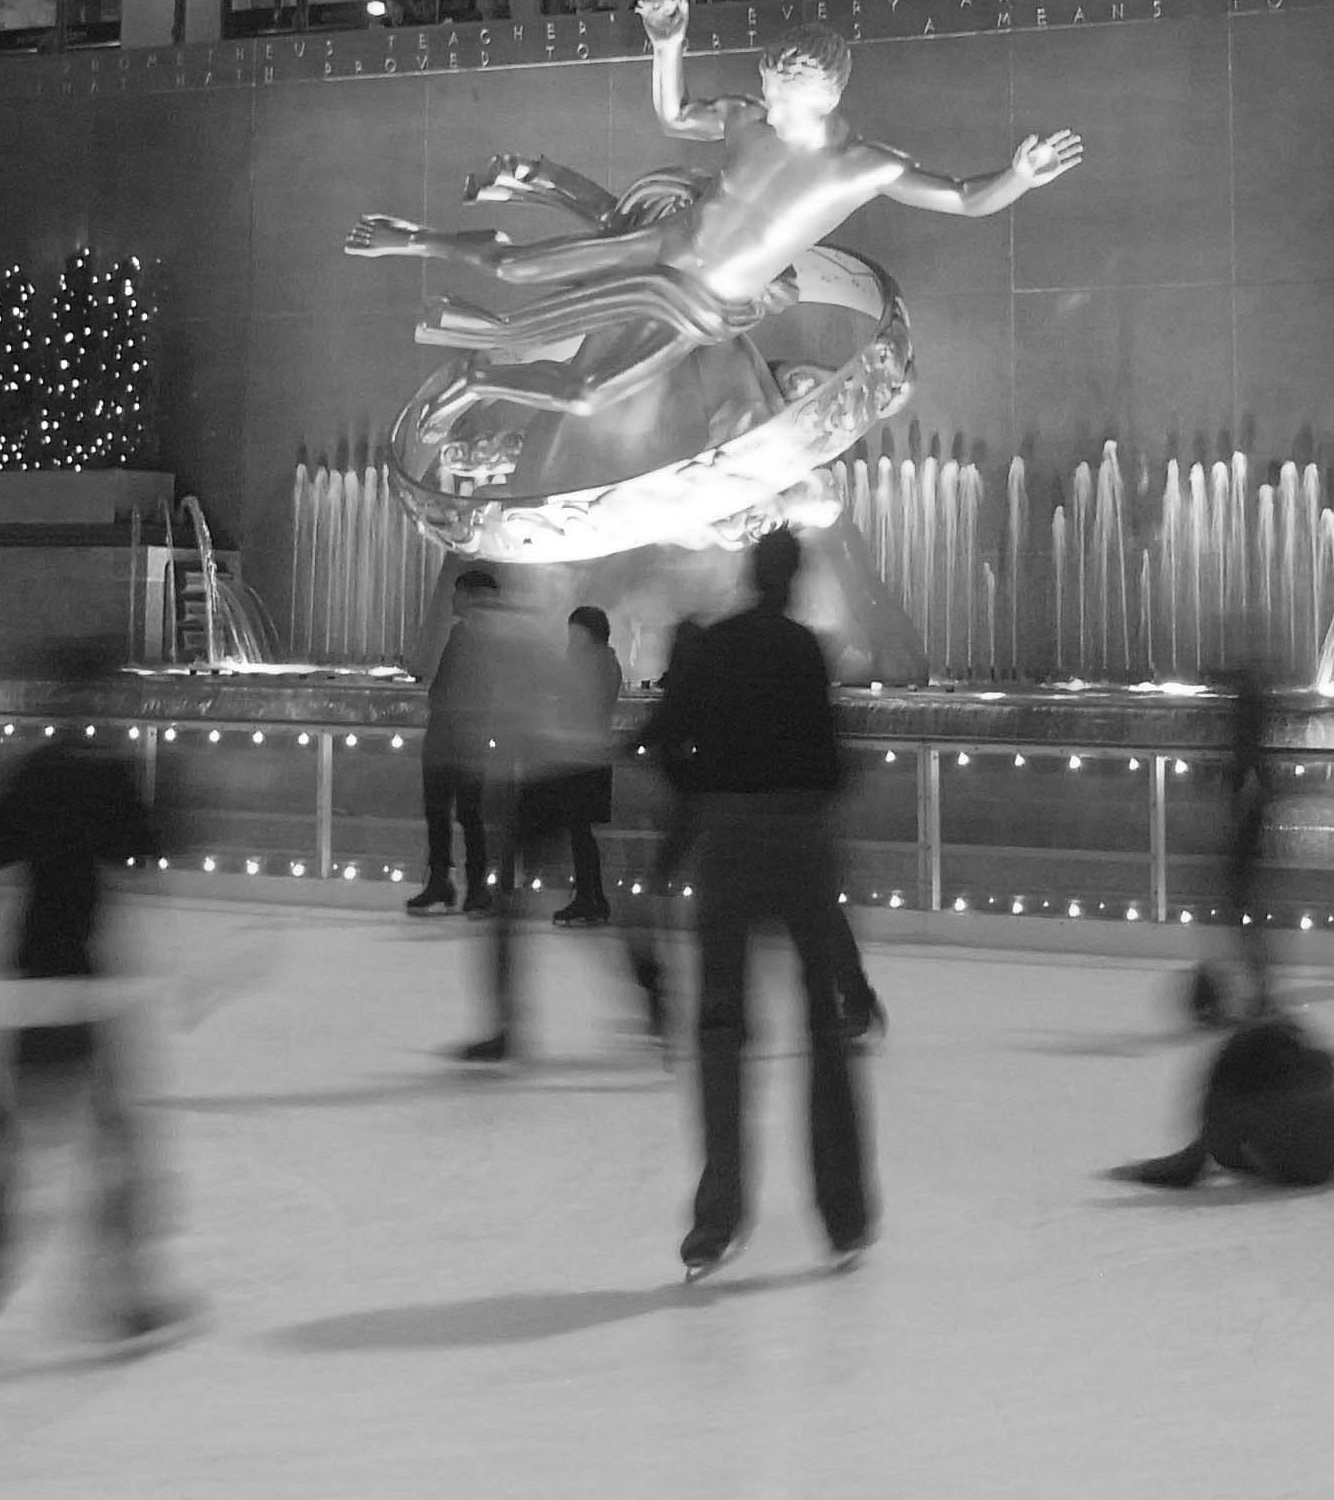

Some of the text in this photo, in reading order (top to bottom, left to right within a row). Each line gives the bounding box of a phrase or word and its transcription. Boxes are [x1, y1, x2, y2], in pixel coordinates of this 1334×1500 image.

[387, 20, 588, 51] TEACHER
[545, 43, 590, 60] TO
[924, 17, 935, 35] A
[997, 0, 1162, 28] MEANS
